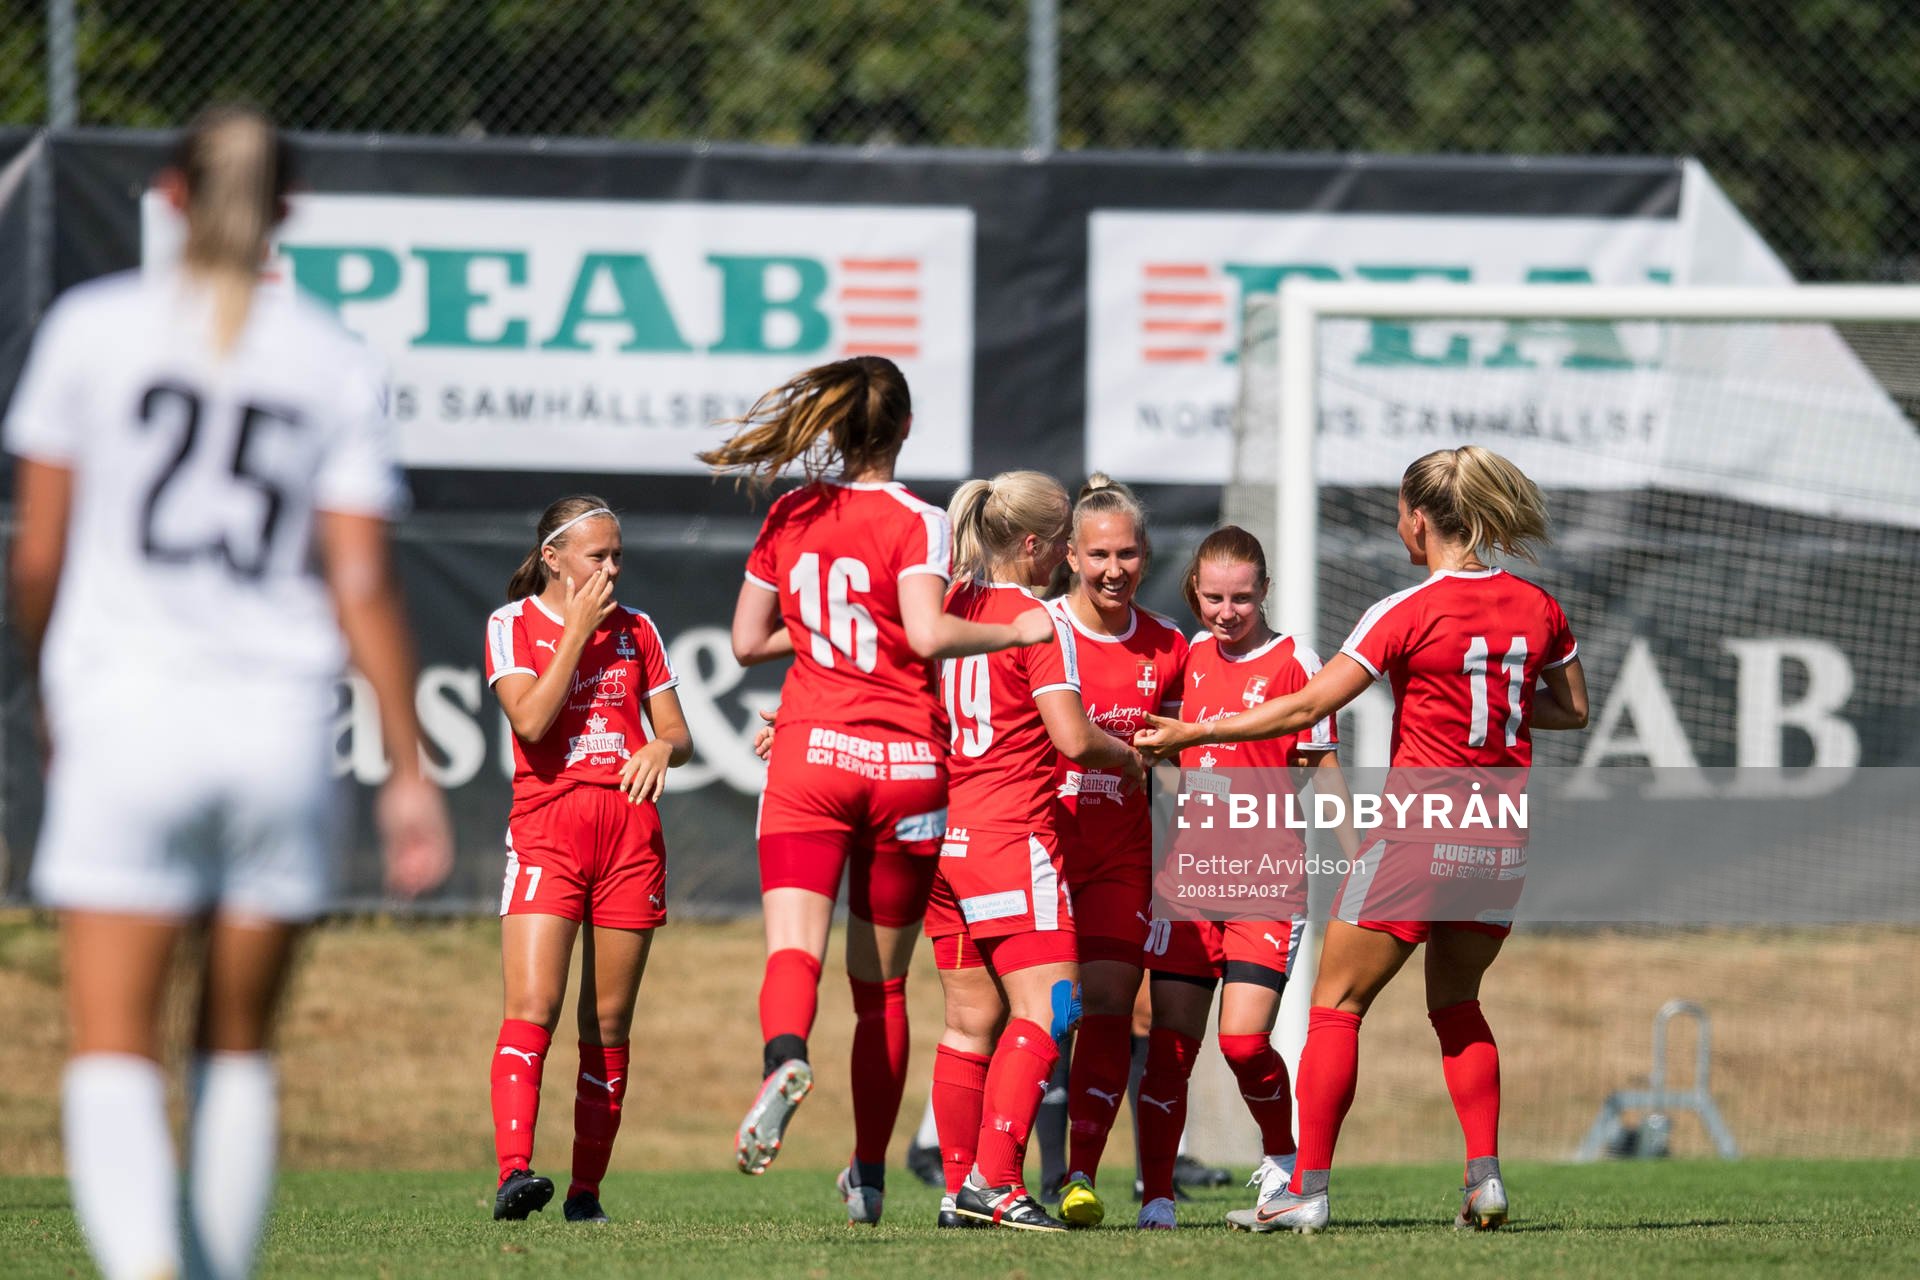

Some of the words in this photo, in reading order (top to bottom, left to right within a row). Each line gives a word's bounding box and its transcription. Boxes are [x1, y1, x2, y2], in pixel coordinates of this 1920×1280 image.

[277, 242, 832, 356] PEAB
[134, 377, 300, 579] 25
[790, 553, 878, 674] 16
[942, 655, 993, 757] 19
[1462, 636, 1527, 747] 11
[1563, 636, 1862, 800] AB
[807, 748, 834, 765] OCH
[836, 753, 887, 780] SERVICE
[809, 728, 884, 762] ROGERS
[525, 866, 543, 901] 7
[1430, 861, 1454, 877] OCH
[1456, 865, 1497, 880] SERVICE
[1433, 843, 1497, 866] ROGERS
[1143, 918, 1172, 956] 10
